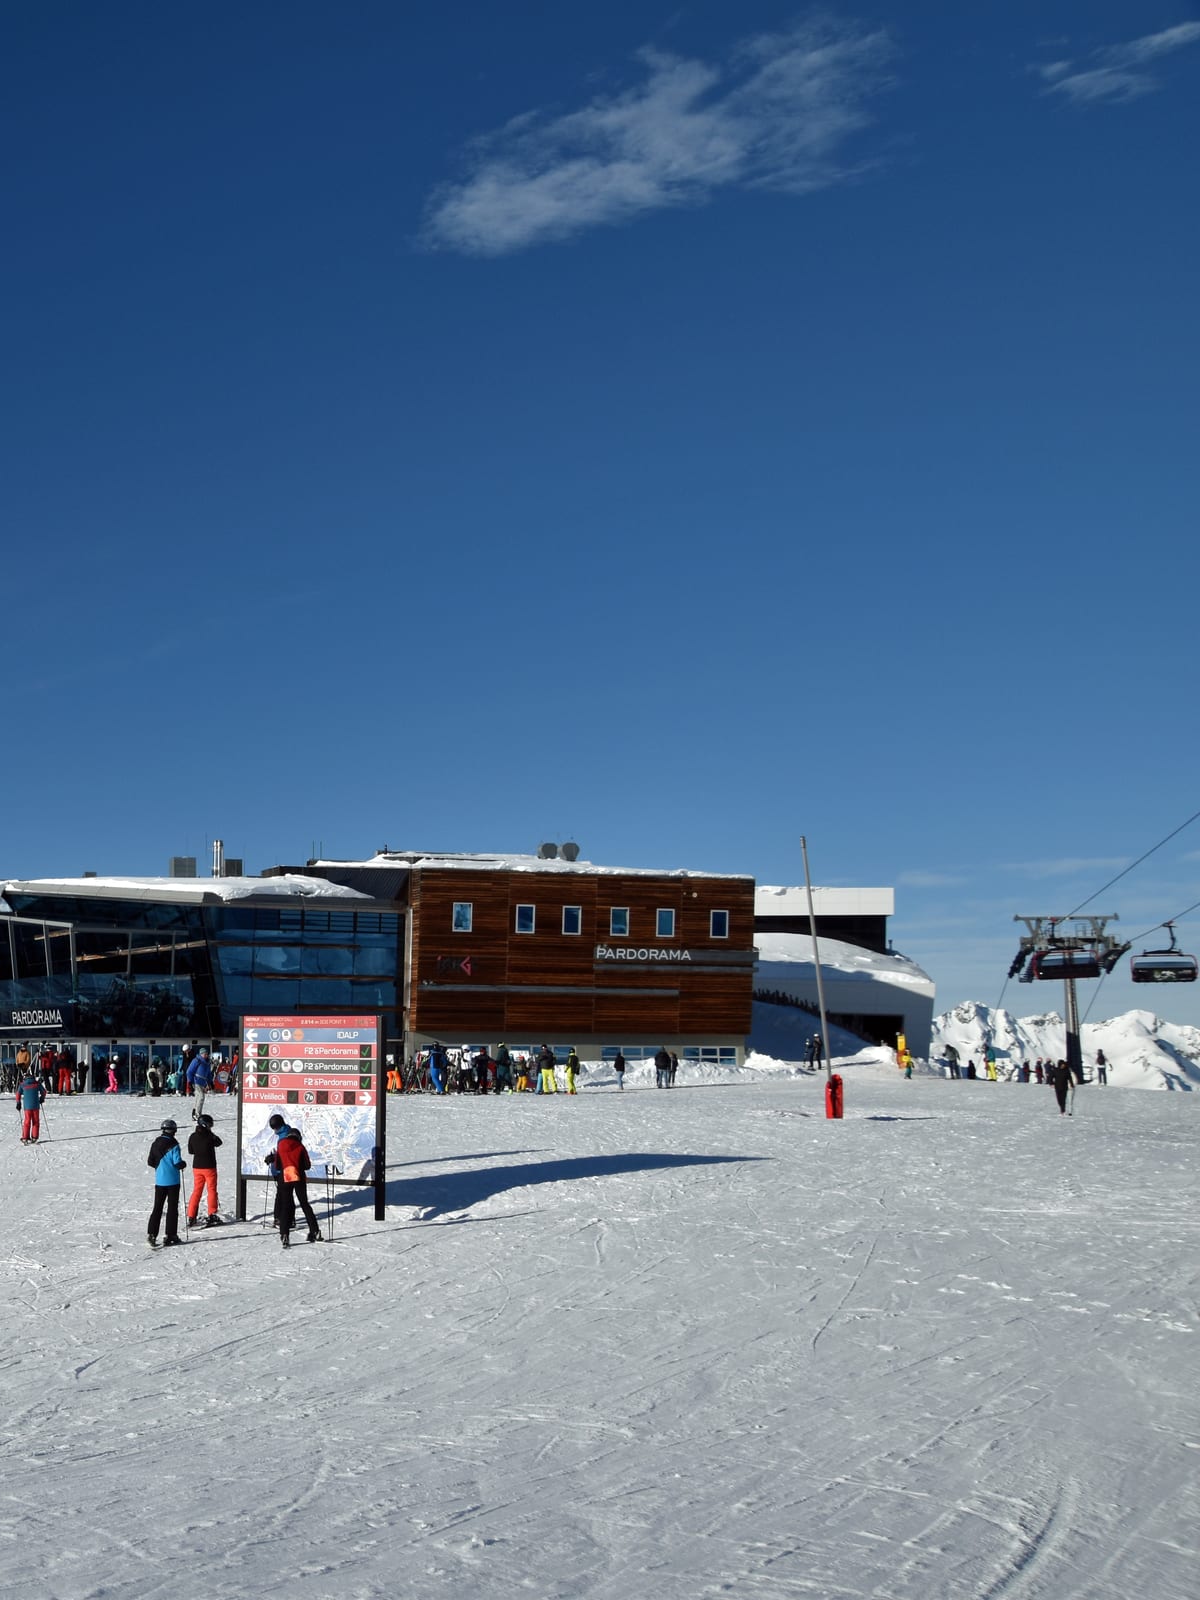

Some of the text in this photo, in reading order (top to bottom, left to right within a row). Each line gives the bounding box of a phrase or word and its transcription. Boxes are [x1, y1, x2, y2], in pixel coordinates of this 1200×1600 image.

[596, 946, 692, 961] PARDORAMA
[11, 1009, 63, 1025] PARDORAMA
[336, 1031, 359, 1039] IDALP
[318, 1047, 358, 1055] Pardorama
[318, 1062, 358, 1071] Pardorama
[318, 1077, 358, 1086] Pardorama
